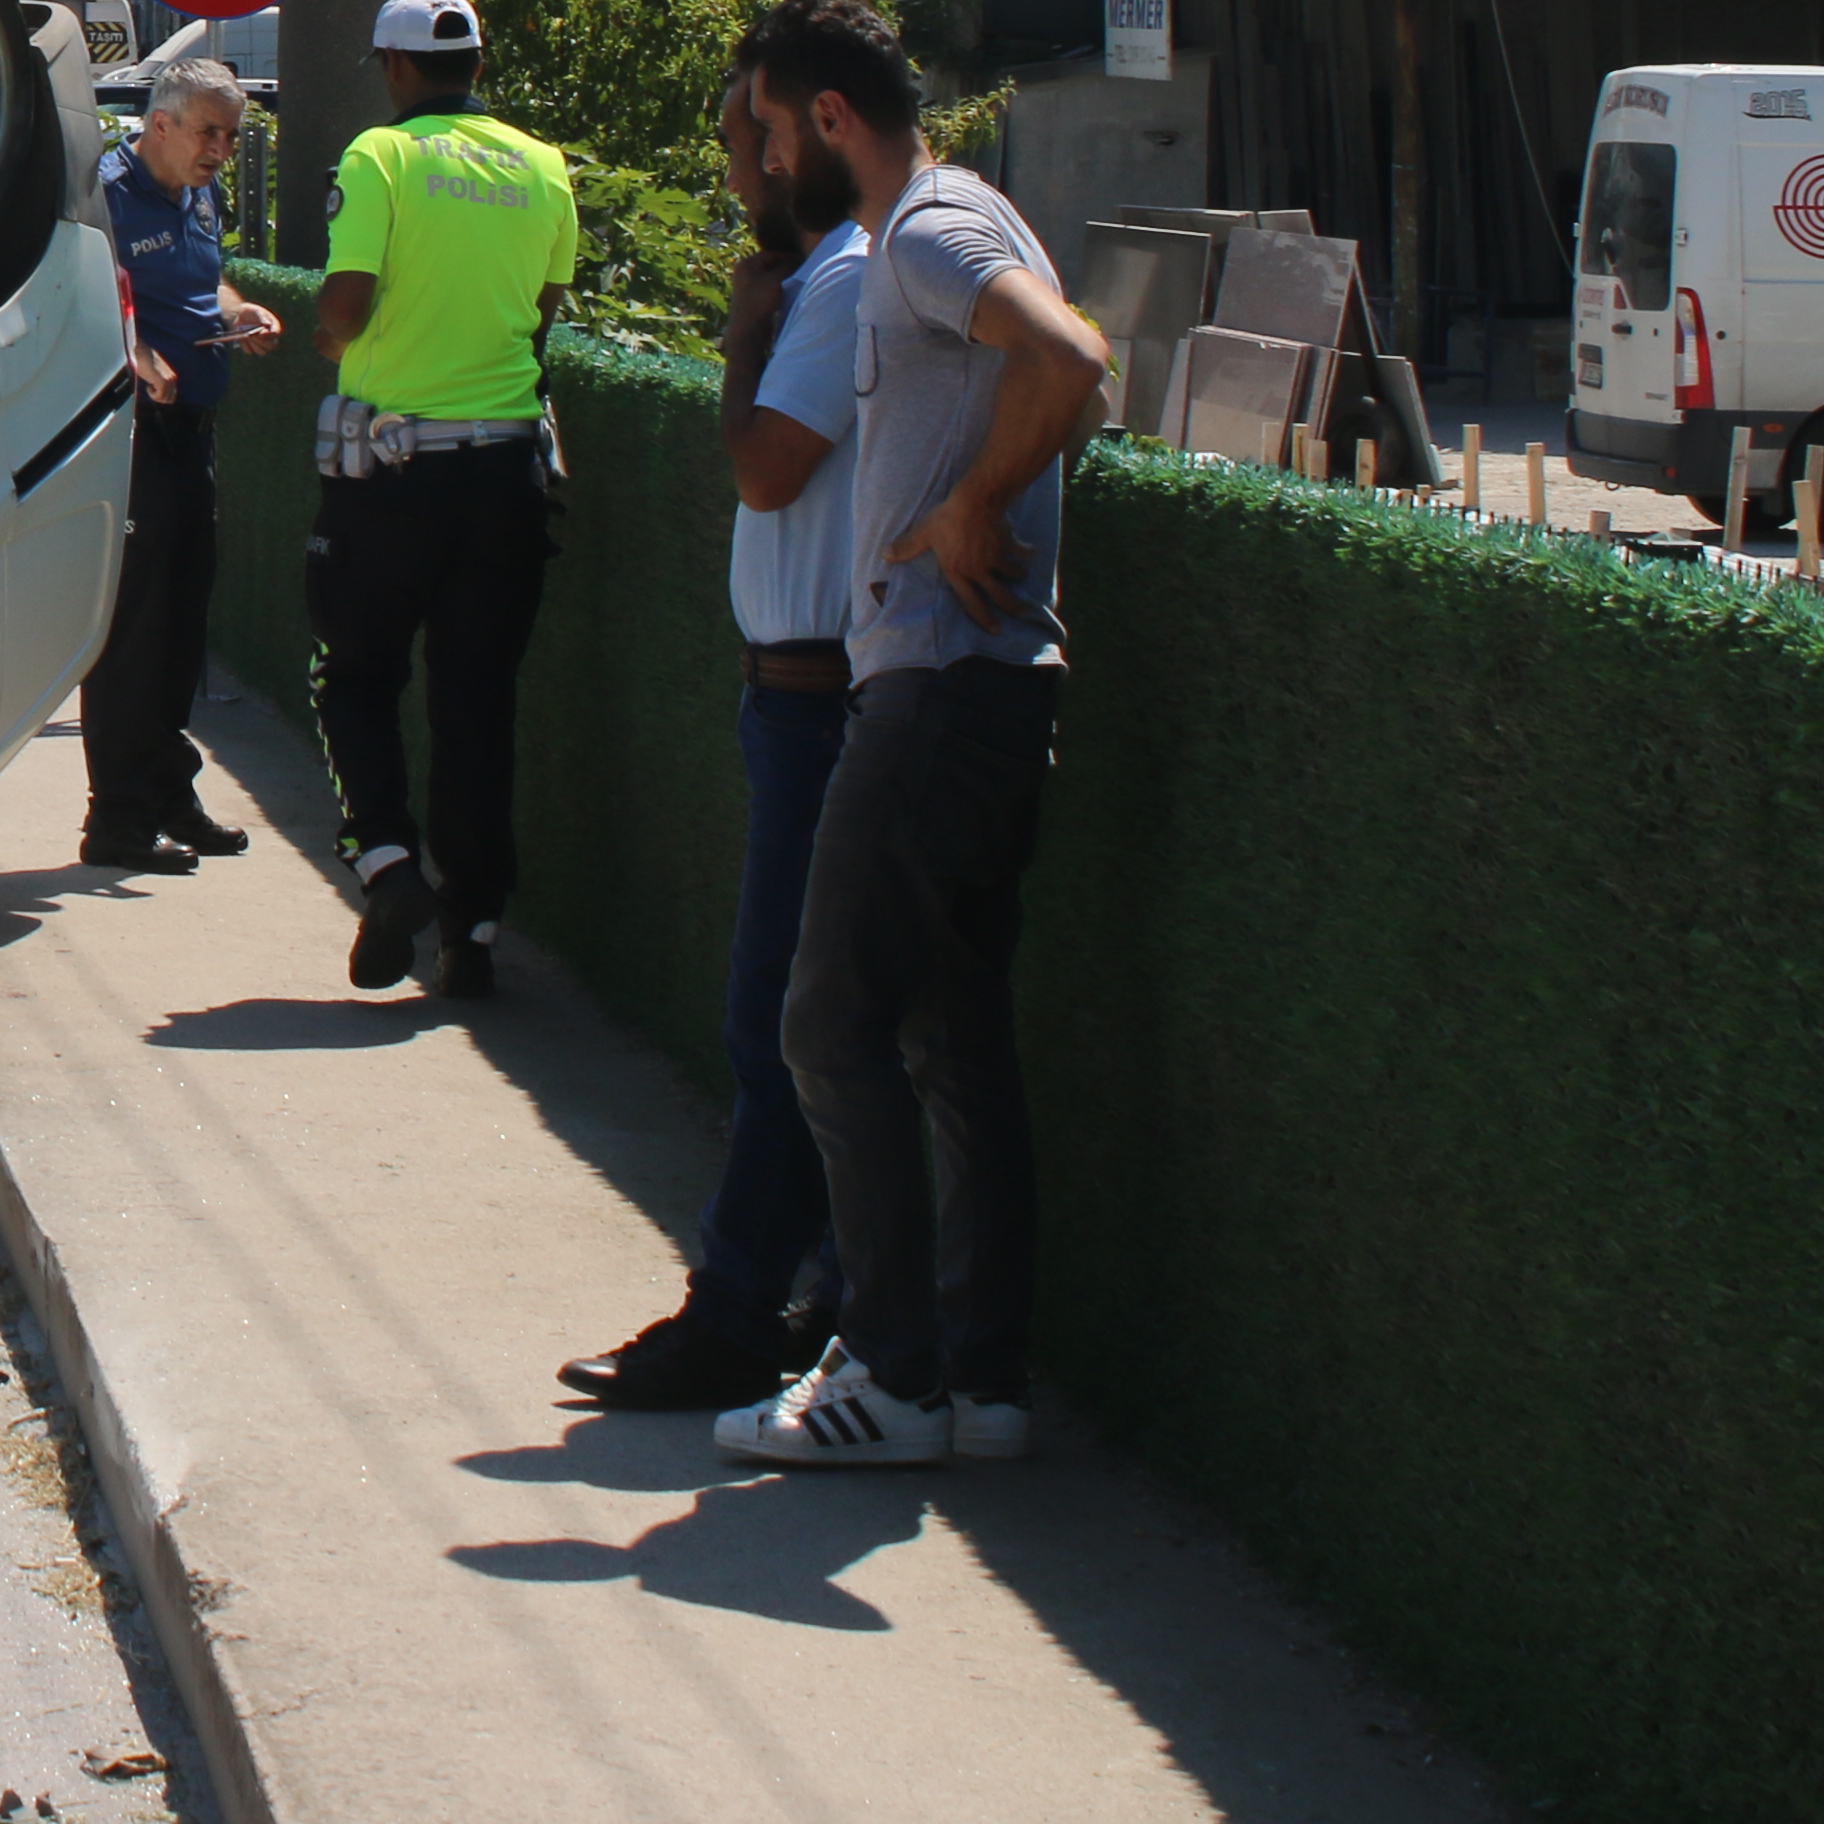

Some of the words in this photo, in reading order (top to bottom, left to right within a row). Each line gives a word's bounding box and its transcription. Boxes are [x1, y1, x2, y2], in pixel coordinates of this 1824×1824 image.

[1108, 0, 1163, 29] MERMER
[413, 135, 532, 171] TRAFİK
[426, 174, 530, 209] POLİSİ
